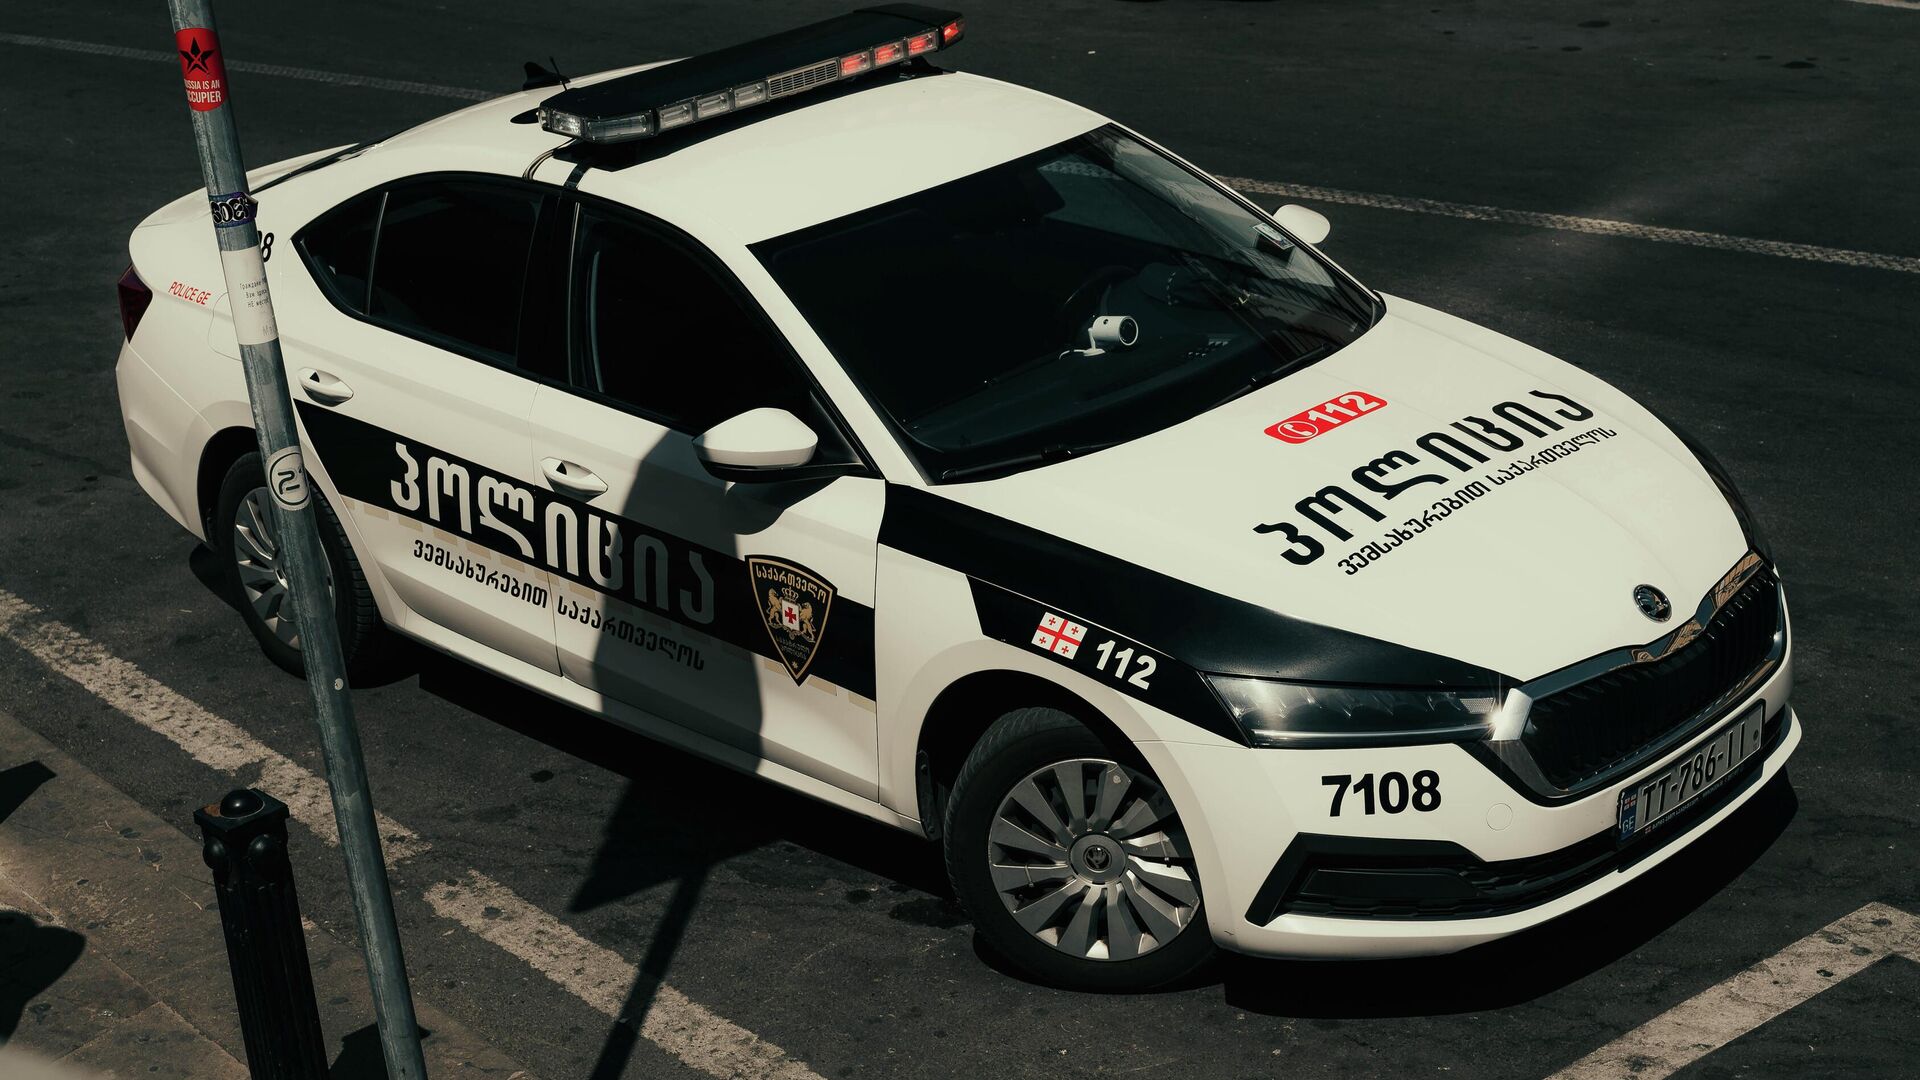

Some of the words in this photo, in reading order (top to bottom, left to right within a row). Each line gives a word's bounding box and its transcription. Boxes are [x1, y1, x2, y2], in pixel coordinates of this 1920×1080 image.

[183, 78, 202, 90] USSIA
[202, 80, 210, 90] IS
[211, 79, 221, 89] AN
[257, 230, 275, 263] 8
[168, 281, 211, 305] POLICE.GE
[1308, 394, 1380, 425] 112
[1253, 389, 1595, 566] პოლიცია
[1337, 480, 1491, 576] ვემსახურებით
[1485, 426, 1617, 486] საქართველოს
[390, 441, 717, 625] პოლიცია
[413, 539, 548, 609] ვემსახურებით
[557, 595, 705, 671] საქართველოს
[755, 564, 827, 604] საქართველო
[1096, 639, 1157, 691] 112
[1321, 769, 1442, 817] 7108
[1622, 815, 1635, 833] GE
